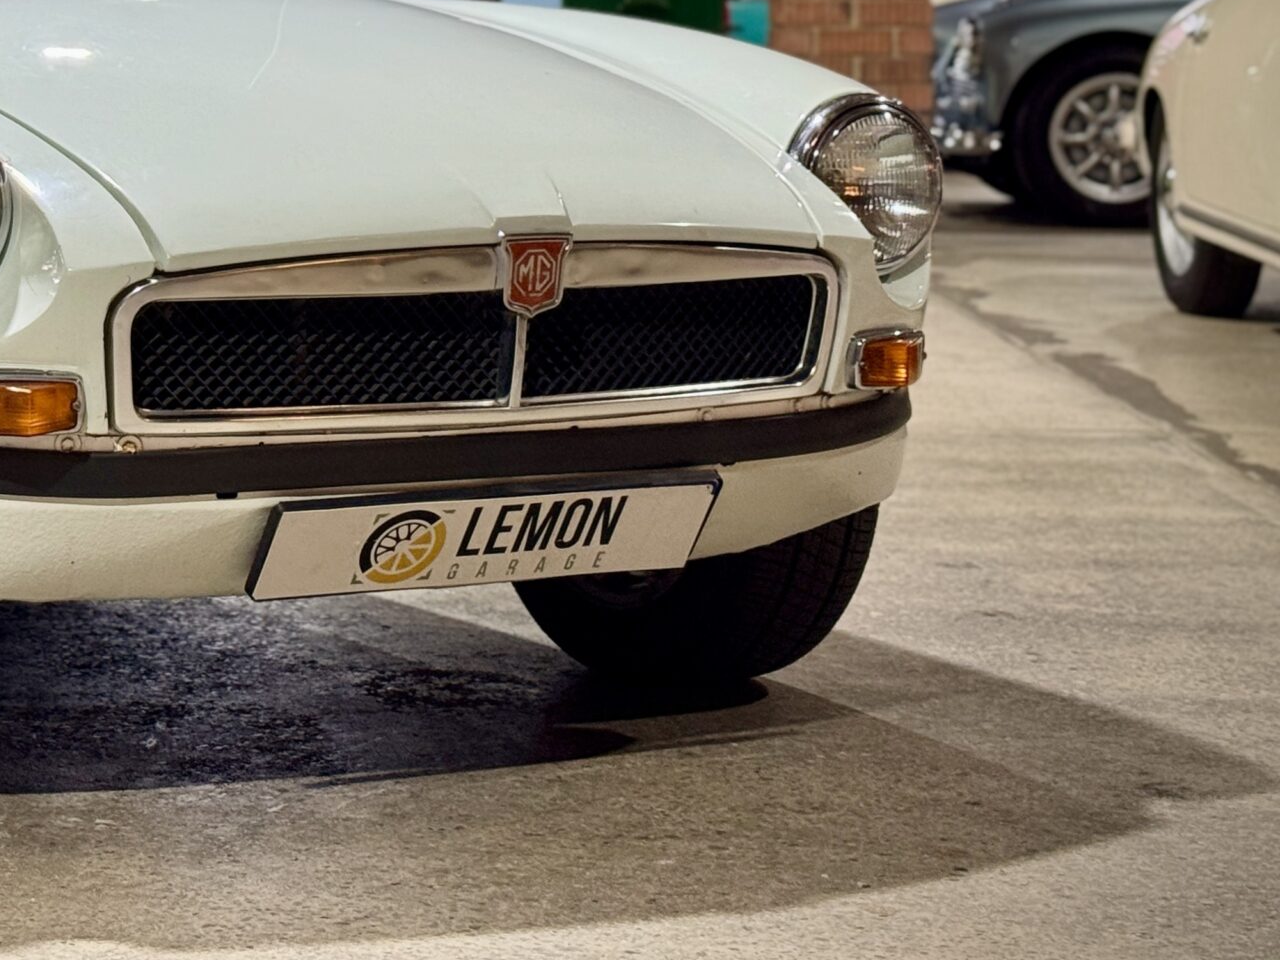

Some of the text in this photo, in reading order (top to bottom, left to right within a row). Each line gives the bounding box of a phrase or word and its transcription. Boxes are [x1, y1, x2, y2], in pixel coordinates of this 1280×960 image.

[518, 254, 552, 292] MG
[455, 495, 628, 557] LEMON
[446, 551, 606, 580] GARAGE
